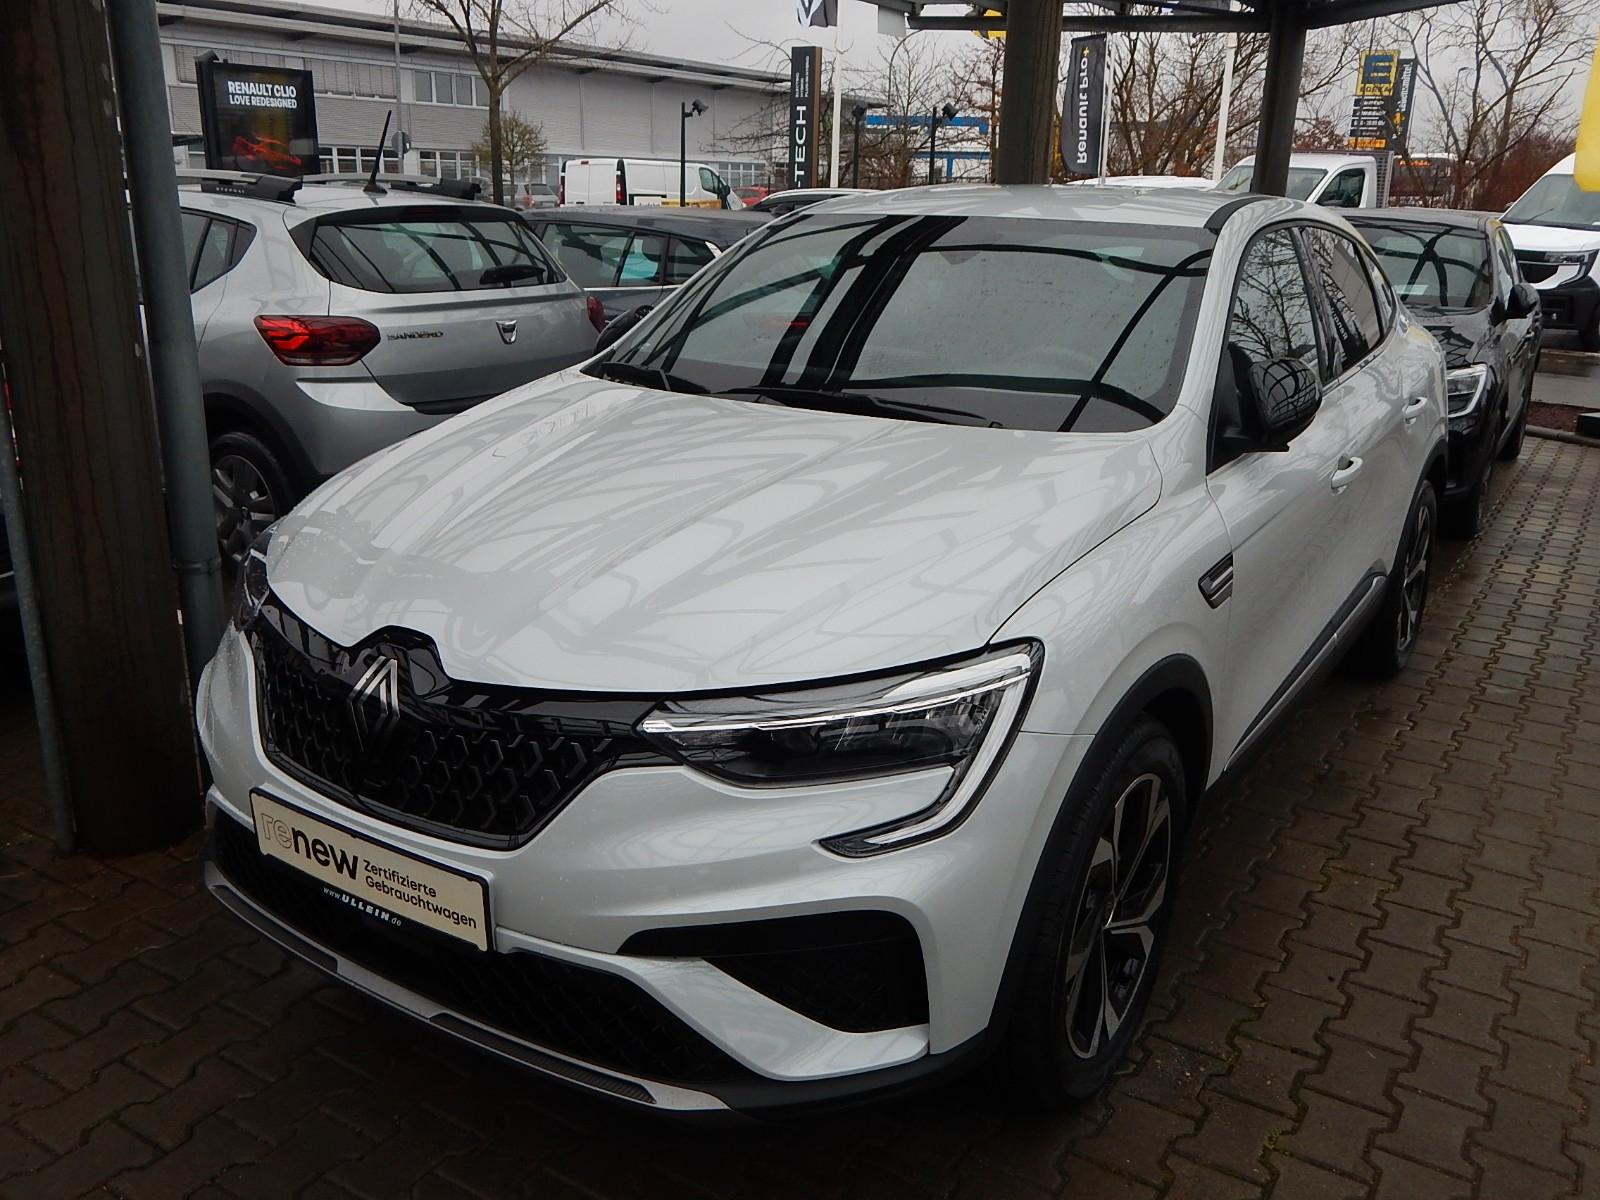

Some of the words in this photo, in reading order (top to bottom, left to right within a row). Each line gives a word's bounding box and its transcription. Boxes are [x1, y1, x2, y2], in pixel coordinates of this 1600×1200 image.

[227, 81, 273, 97] RENAULT
[274, 84, 297, 98] CLIO
[229, 94, 251, 106] LOVE
[251, 96, 297, 109] REDESIGNED
[261, 812, 359, 881] renew
[363, 859, 437, 898] Zertifizierte
[322, 886, 403, 927] www.ULLEIN.de
[365, 875, 478, 929] Gebrauchtwagen
